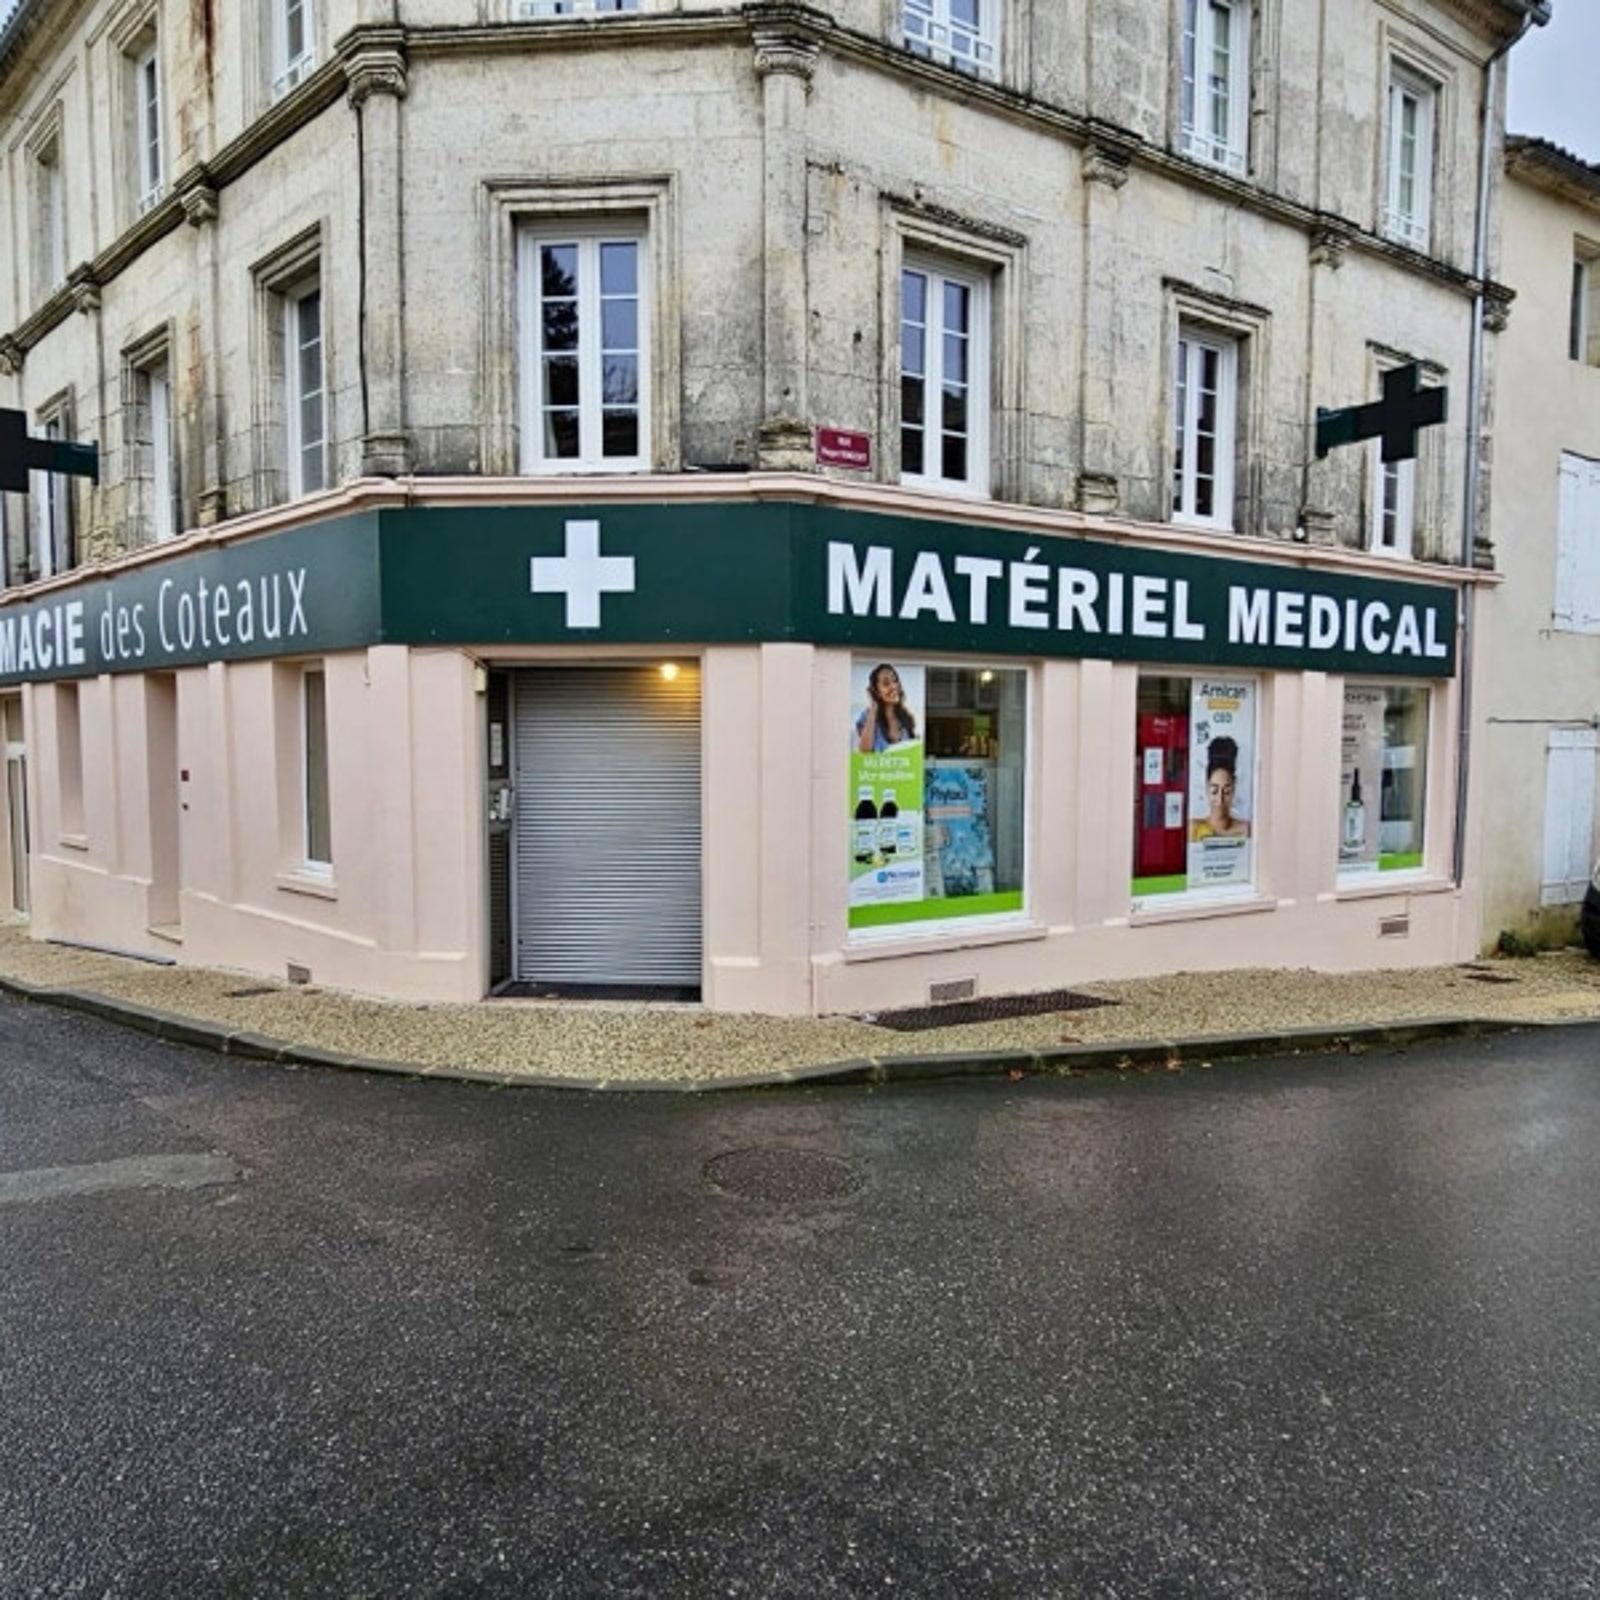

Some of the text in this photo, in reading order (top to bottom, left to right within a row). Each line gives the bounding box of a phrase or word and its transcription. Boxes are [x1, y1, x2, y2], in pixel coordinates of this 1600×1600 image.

[99, 591, 146, 662] des
[157, 567, 309, 653] Coteaux
[826, 541, 1448, 659] MATÉRIEL MEDICAL
[1200, 683, 1246, 699] Arnican
